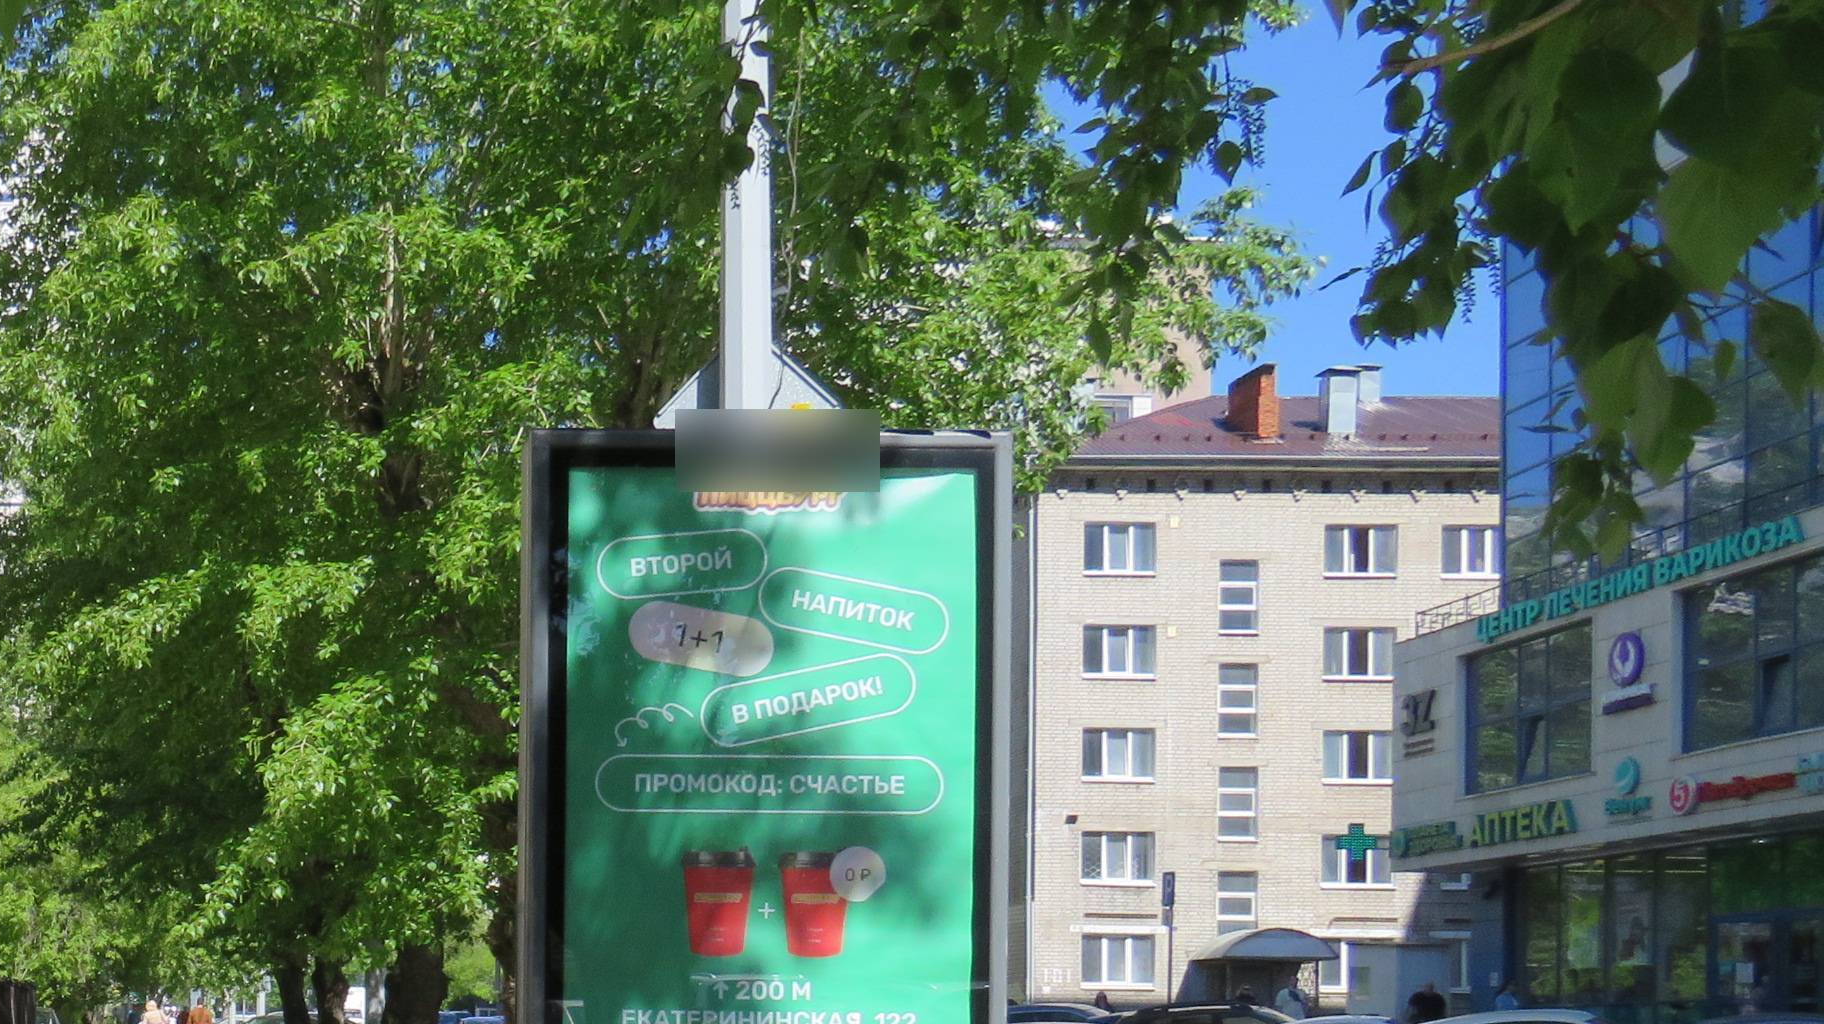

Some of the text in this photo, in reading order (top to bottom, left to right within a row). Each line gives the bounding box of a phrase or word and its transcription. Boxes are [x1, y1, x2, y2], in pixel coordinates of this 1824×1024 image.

[630, 546, 732, 577] ВТОРОЙ
[1477, 515, 1805, 643] ЦЕНТР ЛЕЧЕНИЯ ВАРИКОЗА
[792, 589, 915, 630] НАПИТОК
[675, 623, 724, 654] 1+1
[732, 676, 883, 724] В ПОДАРОК!
[635, 773, 905, 796] ПРОМОКОД: СЧАСТЬЕ
[1471, 799, 1574, 847] АПТЕКА
[735, 981, 811, 1001] 200 М
